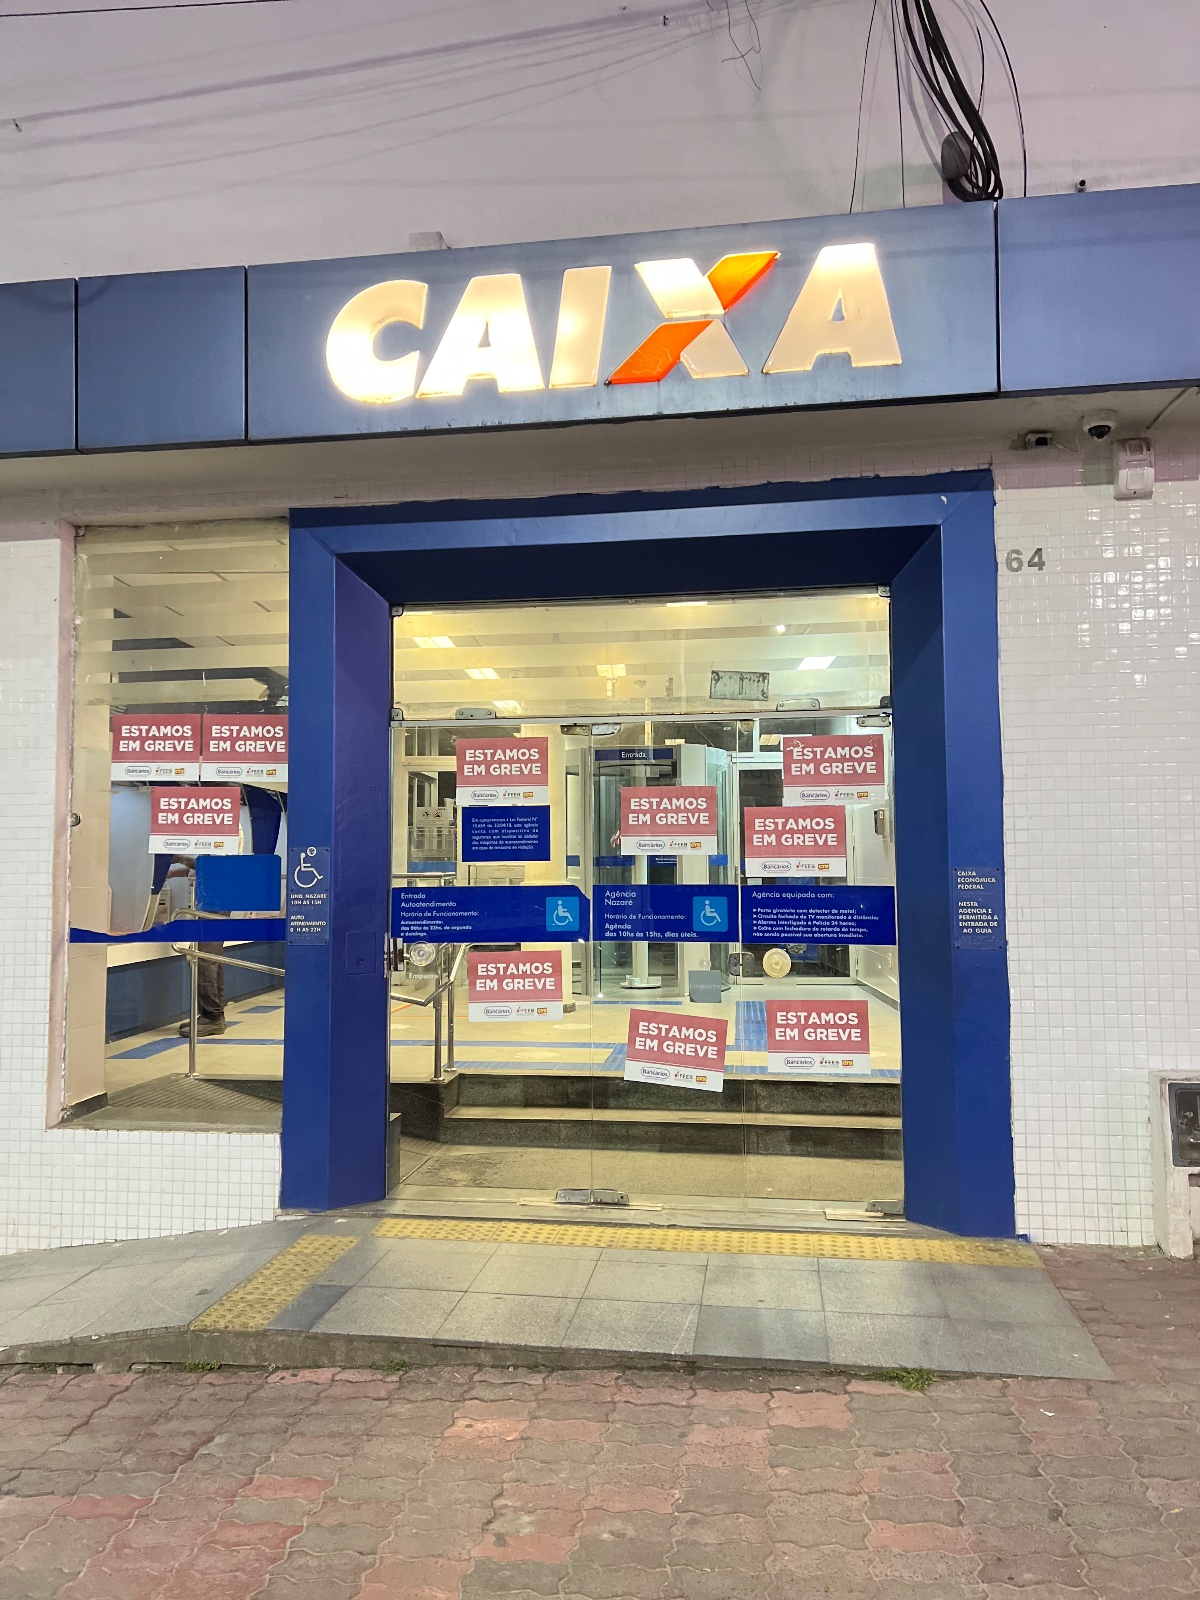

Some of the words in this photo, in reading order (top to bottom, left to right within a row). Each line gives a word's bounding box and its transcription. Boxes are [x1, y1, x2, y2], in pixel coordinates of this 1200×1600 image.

[325, 242, 903, 404] CAIXA
[1005, 547, 1046, 573] 64
[121, 725, 193, 737] ESTAMOS
[211, 726, 284, 738] ESTAMOS
[119, 740, 141, 752] EM
[144, 740, 194, 752] GREVE
[209, 740, 231, 752] EM
[235, 740, 286, 752] GREVE
[465, 748, 540, 762] ESTAMOS
[792, 746, 874, 760] ESTAMOS
[463, 765, 486, 776] EM
[490, 764, 542, 776] GREVE
[791, 762, 815, 775] EM
[819, 761, 877, 775] GREVE
[160, 798, 232, 810] ESTAMOS
[630, 798, 707, 810] ESTAMOS
[158, 813, 179, 825] EM
[183, 813, 234, 825] GREVE
[628, 813, 651, 825] EM
[655, 812, 710, 825] GREVE
[754, 818, 835, 831] ESTAMOS
[753, 833, 777, 846] EM
[780, 833, 838, 846] GREVE
[605, 890, 636, 898] Agência
[752, 891, 780, 899] Agência
[782, 891, 815, 899] equipada
[477, 962, 553, 976] ESTAMOS
[476, 978, 498, 991] EM
[503, 978, 556, 991] GREVE
[776, 1012, 859, 1025] ESTAMOS
[637, 1022, 717, 1042] ESTAMOS
[775, 1028, 799, 1041] EM
[803, 1028, 862, 1041] GREVE
[634, 1037, 659, 1052] EM
[662, 1041, 718, 1059] GREVE
